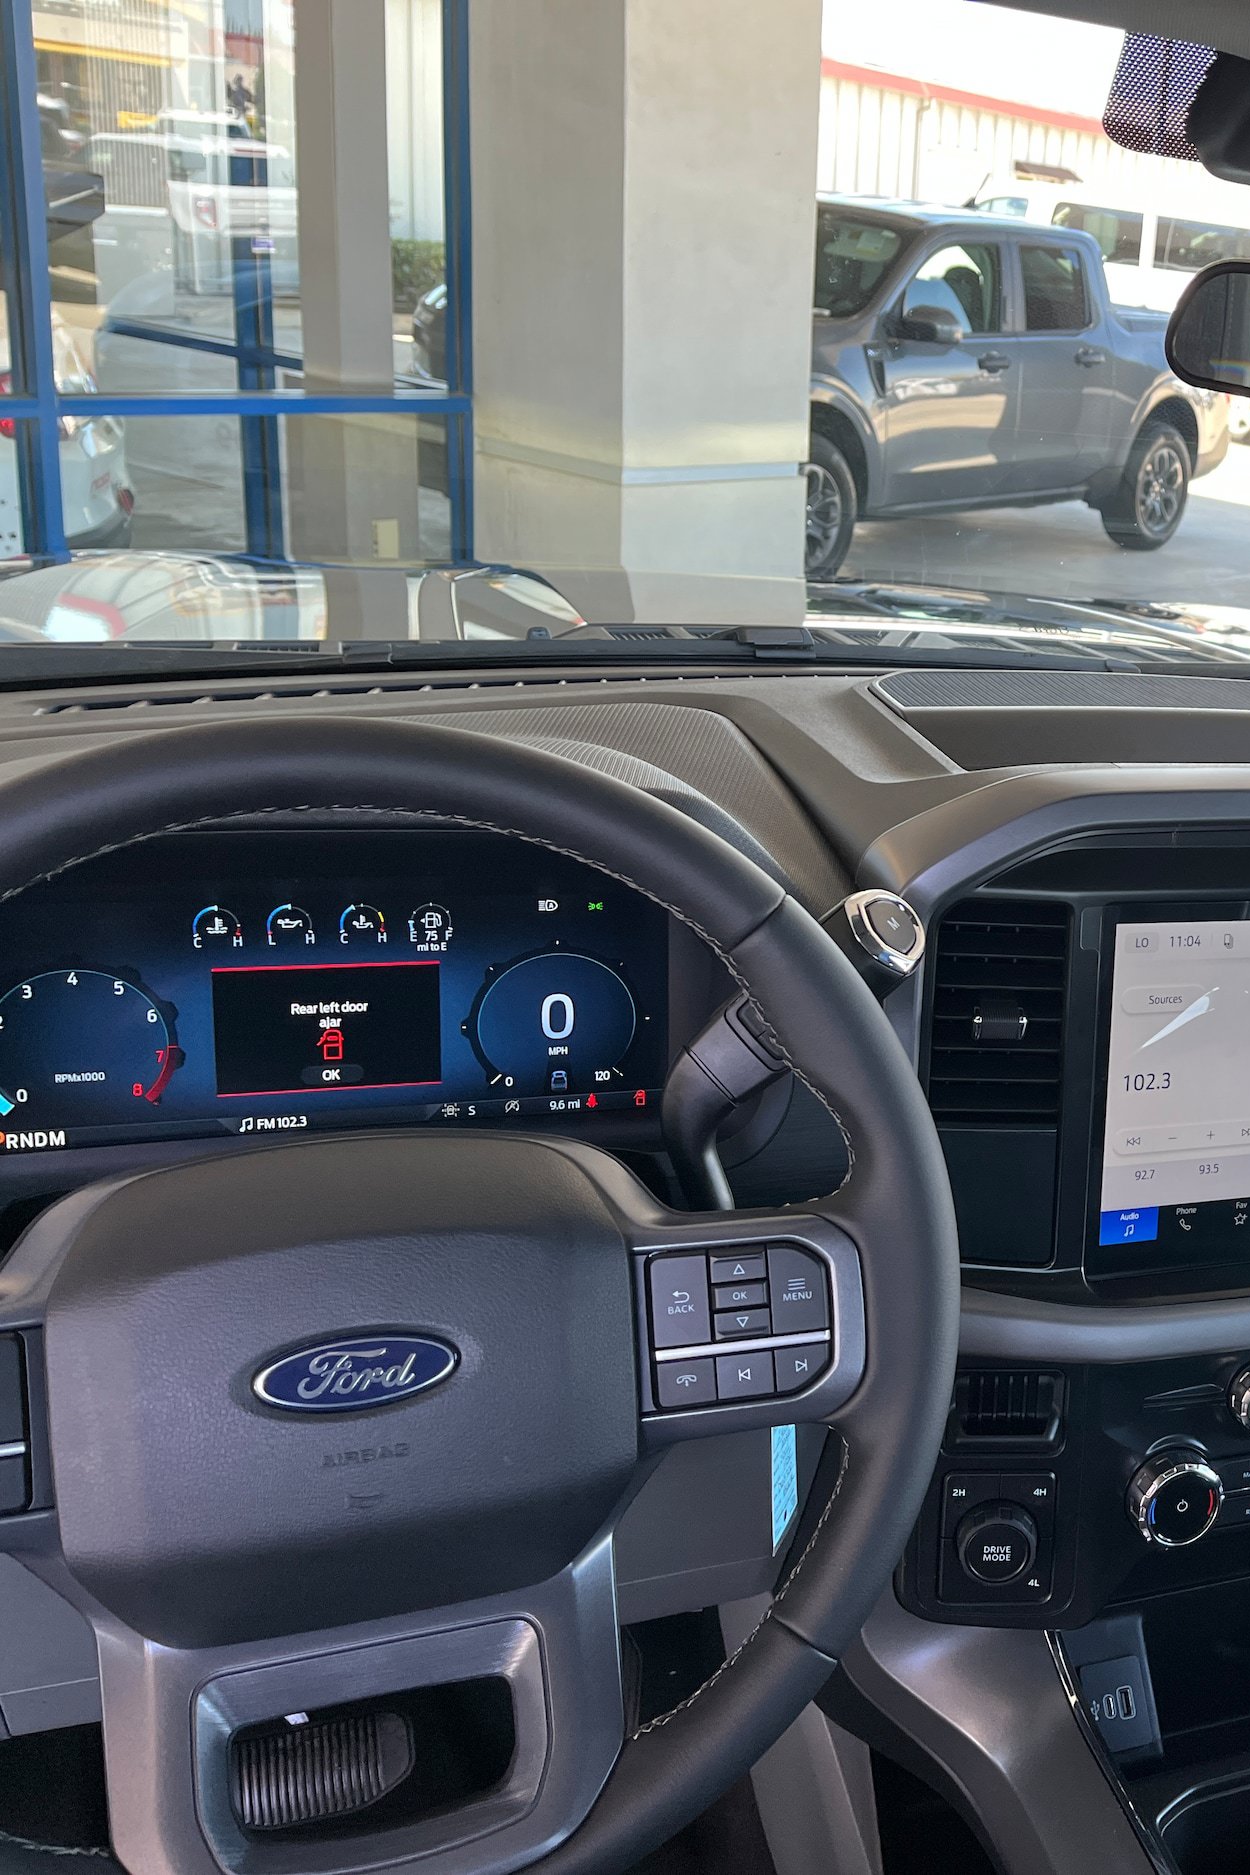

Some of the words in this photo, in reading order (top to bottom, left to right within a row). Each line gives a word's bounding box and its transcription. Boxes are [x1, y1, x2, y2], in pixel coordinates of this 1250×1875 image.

[233, 936, 243, 947] H
[268, 935, 276, 945] L
[305, 933, 315, 944] H
[340, 933, 349, 944] C
[377, 932, 387, 943] H
[409, 931, 418, 942] E
[425, 931, 438, 942] 75
[1170, 935, 1201, 948] 11:04
[193, 937, 202, 948] C
[430, 943, 440, 951] to
[441, 942, 447, 951] E
[1135, 937, 1149, 948] LO
[67, 972, 78, 985] 4
[22, 985, 32, 999] 3
[114, 982, 124, 995] 5
[1148, 994, 1182, 1005] Sources
[291, 1003, 318, 1015] Rear
[319, 1002, 340, 1014] left
[341, 1001, 368, 1013] door
[147, 1009, 158, 1023] 6
[541, 993, 575, 1040] 0
[319, 1016, 342, 1029] ajar
[155, 1051, 164, 1062] 7
[549, 1046, 568, 1056] MPH
[55, 1072, 105, 1083] RPMx1000
[322, 1069, 340, 1081] OK
[595, 1071, 610, 1081] 120
[505, 1076, 513, 1087] 0
[1123, 1072, 1171, 1092] 102.3
[16, 1089, 28, 1103] 0
[133, 1084, 143, 1097] 8
[550, 1101, 565, 1111] 9.6
[568, 1099, 581, 1109] mi
[468, 1106, 476, 1116] S
[257, 1118, 275, 1130] FM
[277, 1116, 307, 1128] 102.3
[1199, 1164, 1219, 1175] 93.5
[1135, 1170, 1155, 1181] 92.7
[1176, 1206, 1197, 1216] Phone
[1235, 1201, 1248, 1210] Fav
[1120, 1212, 1140, 1221] Audio
[733, 1291, 748, 1300] OK
[783, 1291, 812, 1302] MENU
[667, 1304, 695, 1315] BACK
[297, 1347, 417, 1399] Ford
[321, 1443, 411, 1467] AIRBAG
[952, 1489, 966, 1497] 2H
[1033, 1488, 1047, 1496] 4H
[1028, 1579, 1040, 1587] 4L
